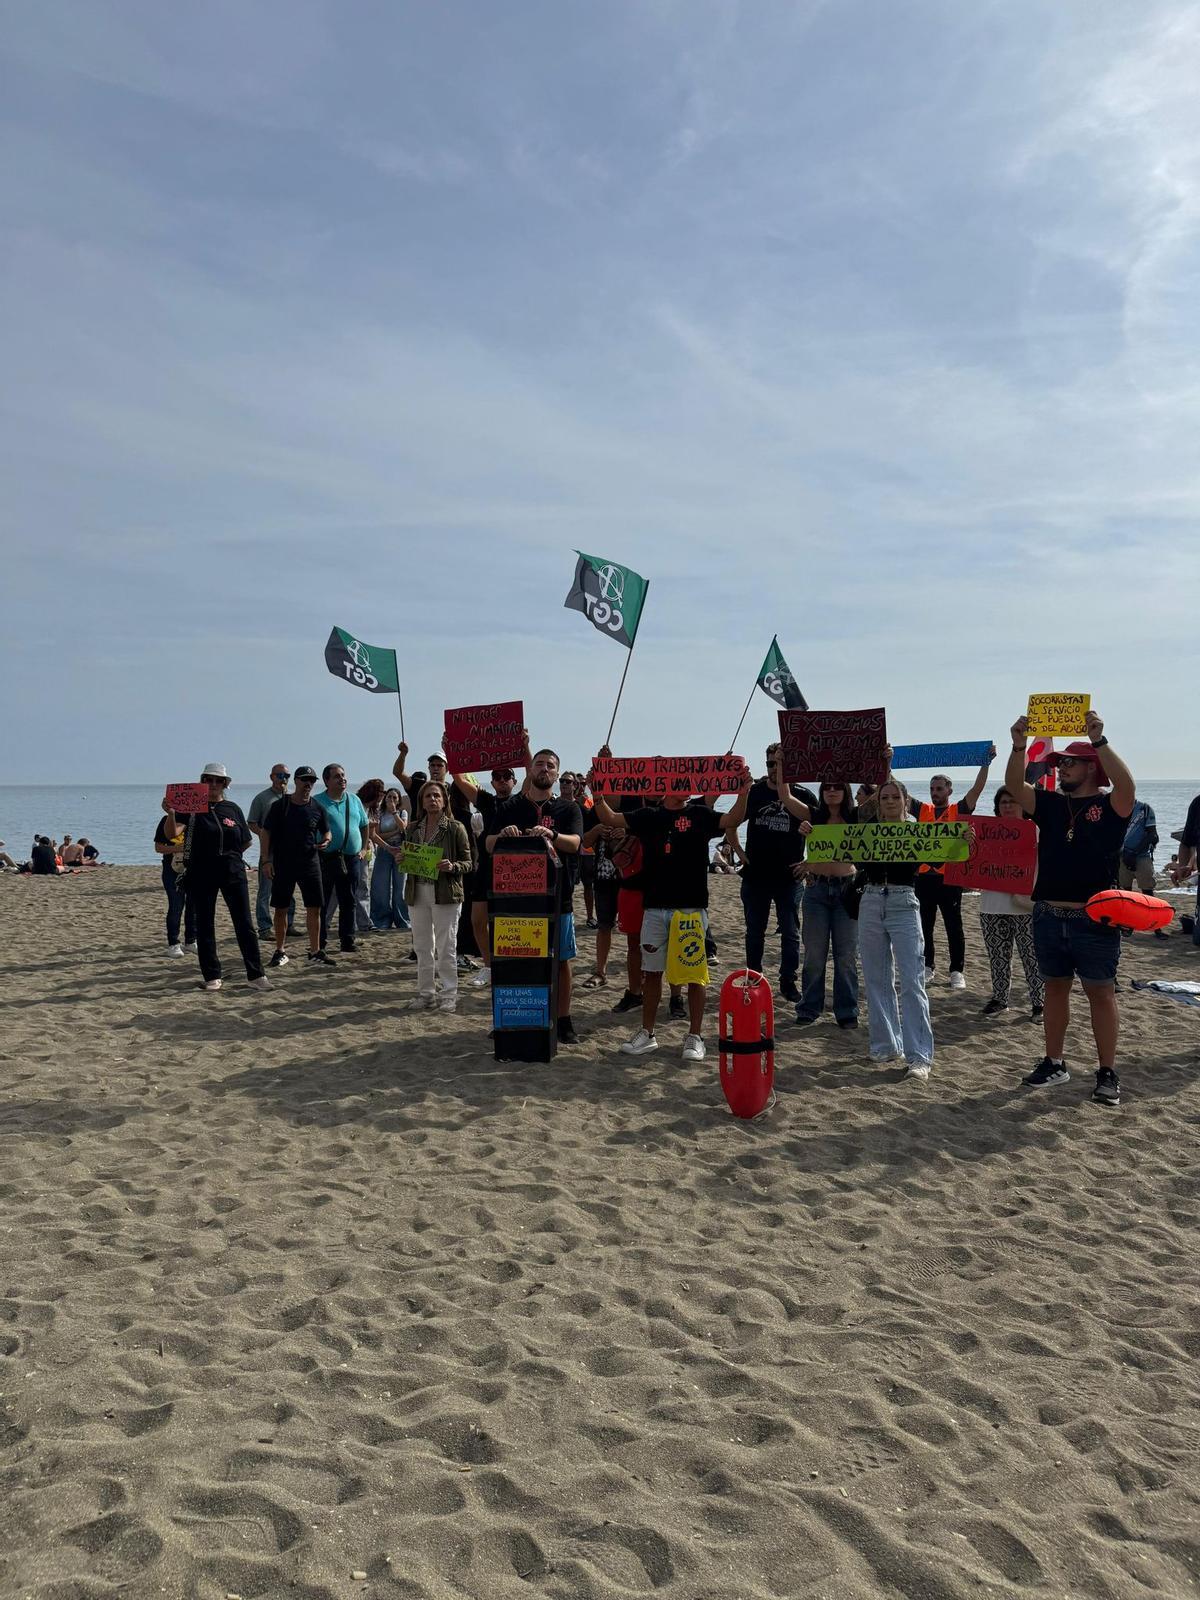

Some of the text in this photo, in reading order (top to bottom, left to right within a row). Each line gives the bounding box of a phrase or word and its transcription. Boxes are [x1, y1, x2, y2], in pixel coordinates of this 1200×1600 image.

[1027, 716, 1042, 724] DEL
[1060, 725, 1088, 734] ABUSO
[652, 758, 709, 774] TRABAJO
[654, 776, 667, 792] ES
[808, 840, 834, 852] CADA
[873, 840, 910, 852] PUEDE
[913, 840, 942, 852] SER
[833, 848, 854, 861] LA
